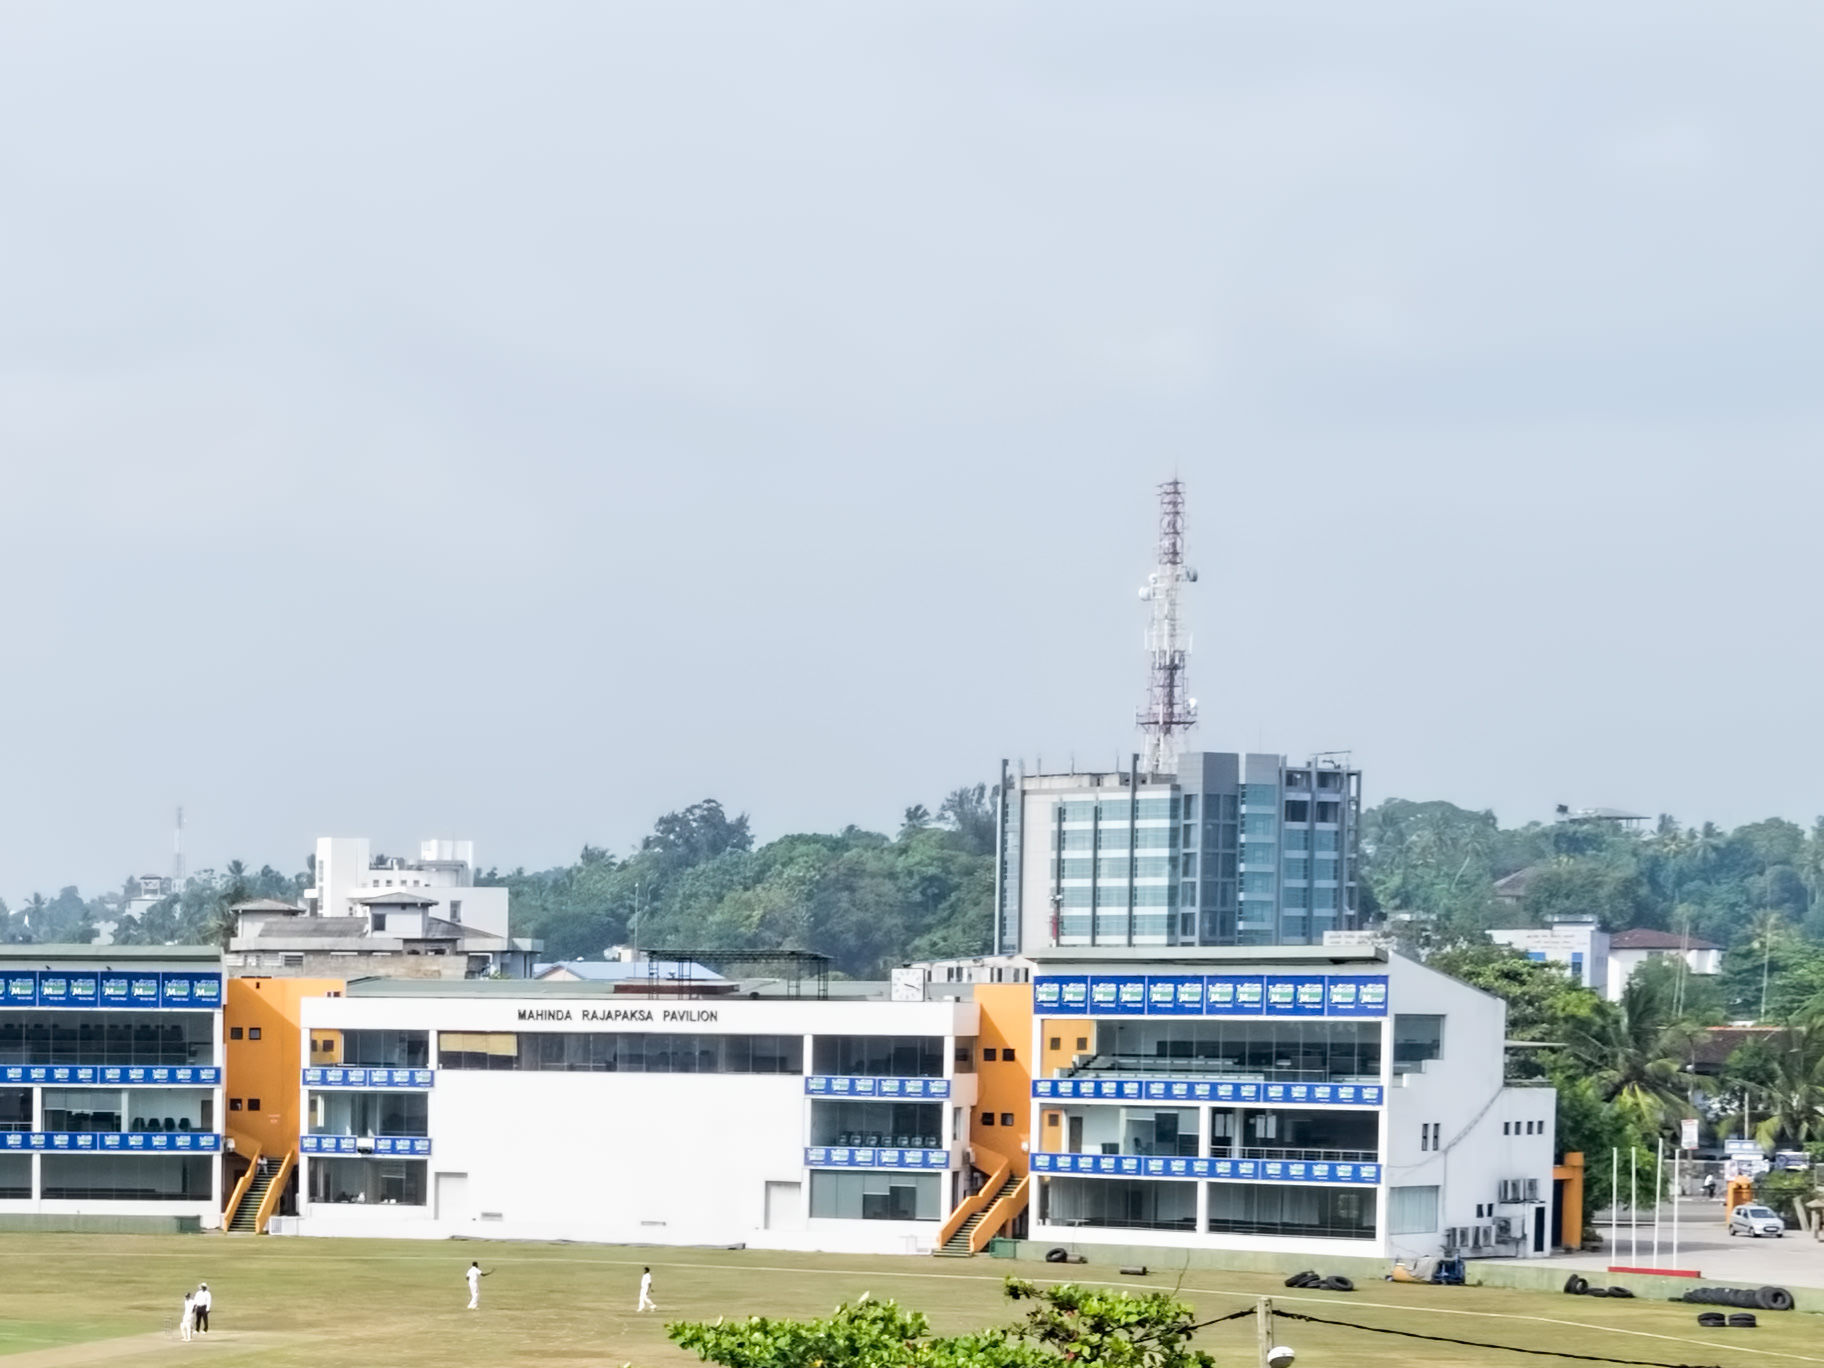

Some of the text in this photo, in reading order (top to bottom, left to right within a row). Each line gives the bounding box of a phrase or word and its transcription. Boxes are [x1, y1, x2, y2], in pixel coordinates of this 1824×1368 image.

[517, 1009, 718, 1022] MAHINDA RAJAPAKSA PAVILION
